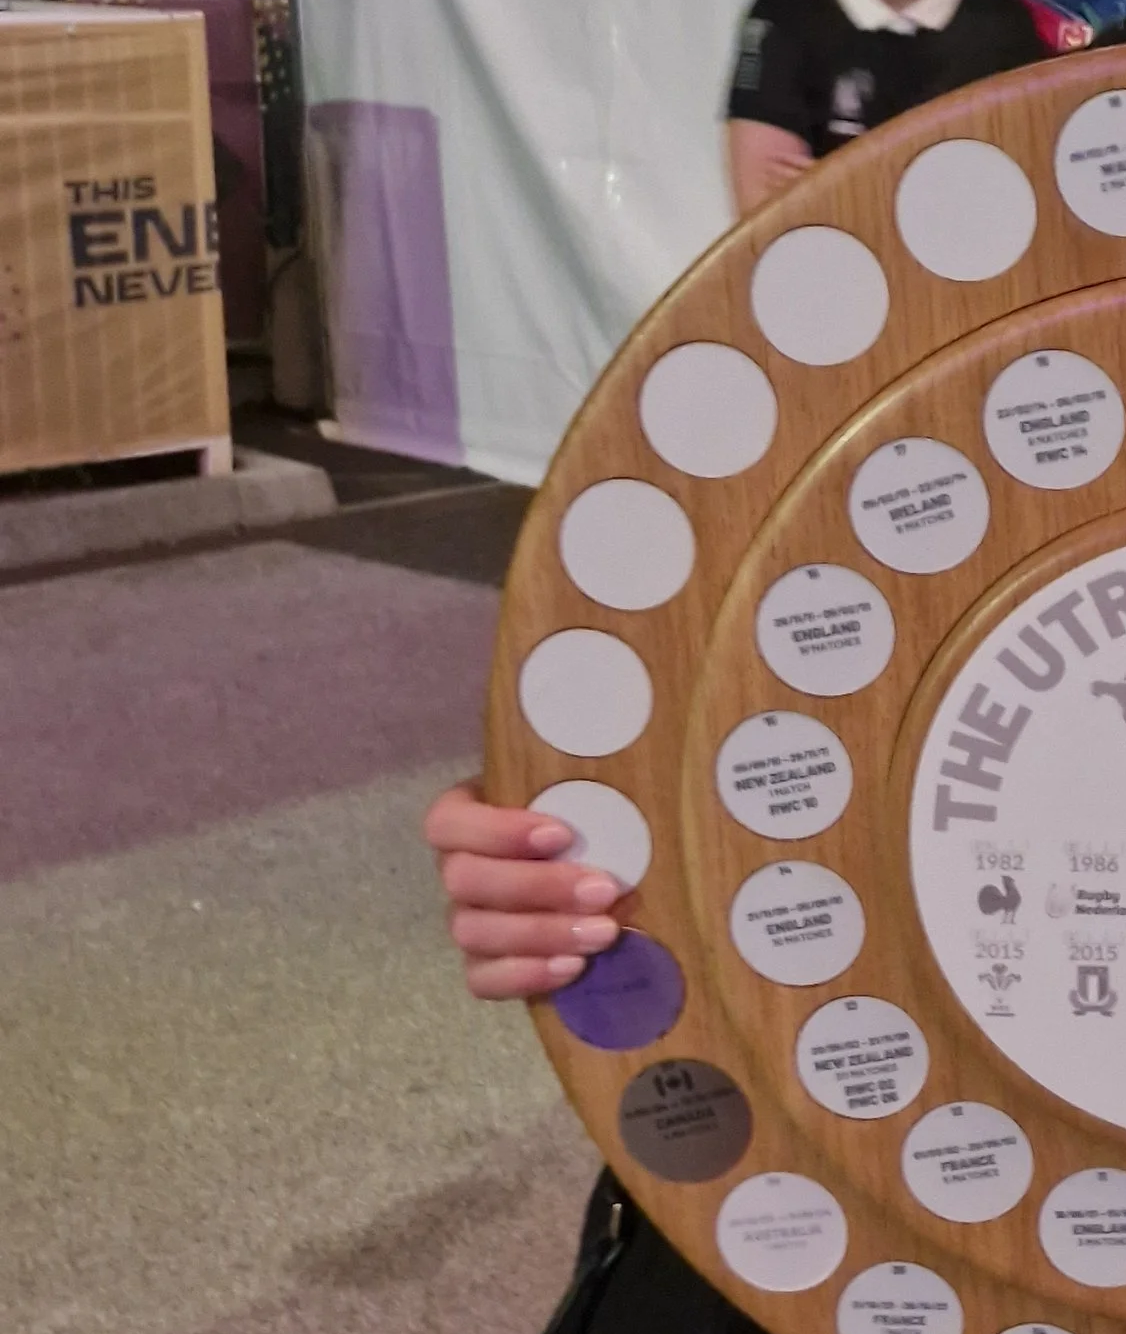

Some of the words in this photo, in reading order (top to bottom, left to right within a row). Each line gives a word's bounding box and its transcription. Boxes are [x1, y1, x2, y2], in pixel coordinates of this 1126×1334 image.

[64, 175, 156, 204] THIS
[1019, 409, 1091, 434] ENGLAND
[888, 493, 952, 522] IRELAND
[790, 619, 861, 643] ENGLAND
[933, 682, 1034, 832] THE
[734, 775, 768, 792] NEW
[769, 761, 837, 785] ZEALAND
[975, 854, 1025, 872] 1982
[1069, 856, 1119, 873] 1986
[1077, 889, 1121, 904] Rugby
[765, 913, 832, 936] ENGLAND
[975, 943, 1025, 961] 2015
[1068, 945, 1119, 963] 2015
[813, 1056, 845, 1072] NEW
[847, 1046, 914, 1066] ZEALAND
[940, 1154, 997, 1172] FRANCE
[742, 1223, 823, 1243] AUSTRALIA
[871, 1313, 928, 1327] FRANCE
